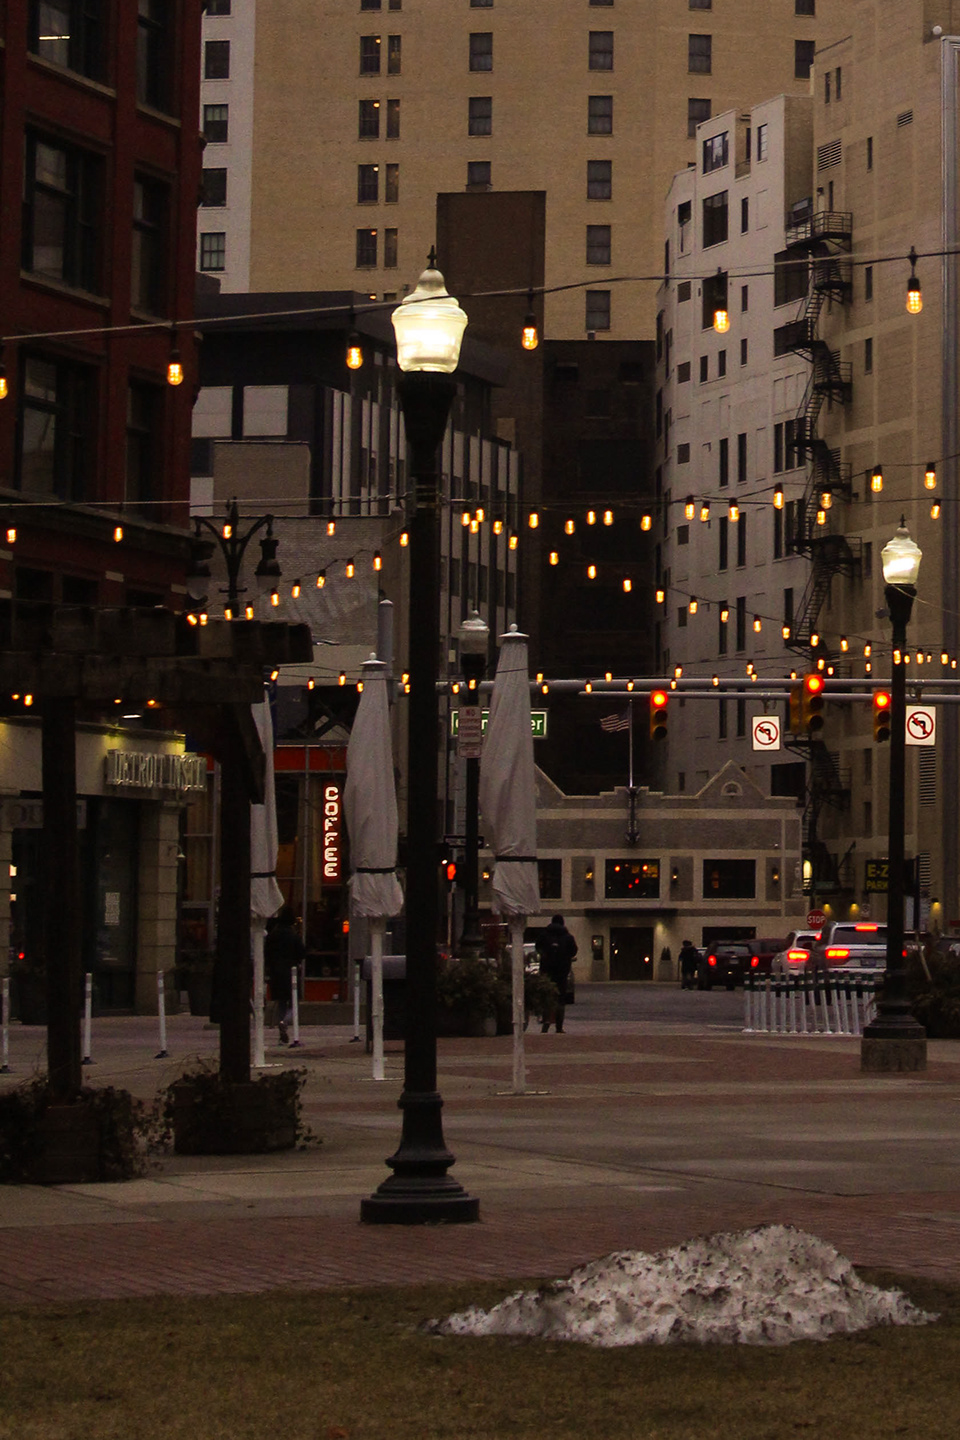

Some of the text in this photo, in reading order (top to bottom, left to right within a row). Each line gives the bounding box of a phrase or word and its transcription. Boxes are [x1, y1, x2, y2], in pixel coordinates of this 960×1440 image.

[324, 786, 339, 877] COFFEE
[867, 864, 889, 878] E-Z
[807, 915, 826, 924] STOP
